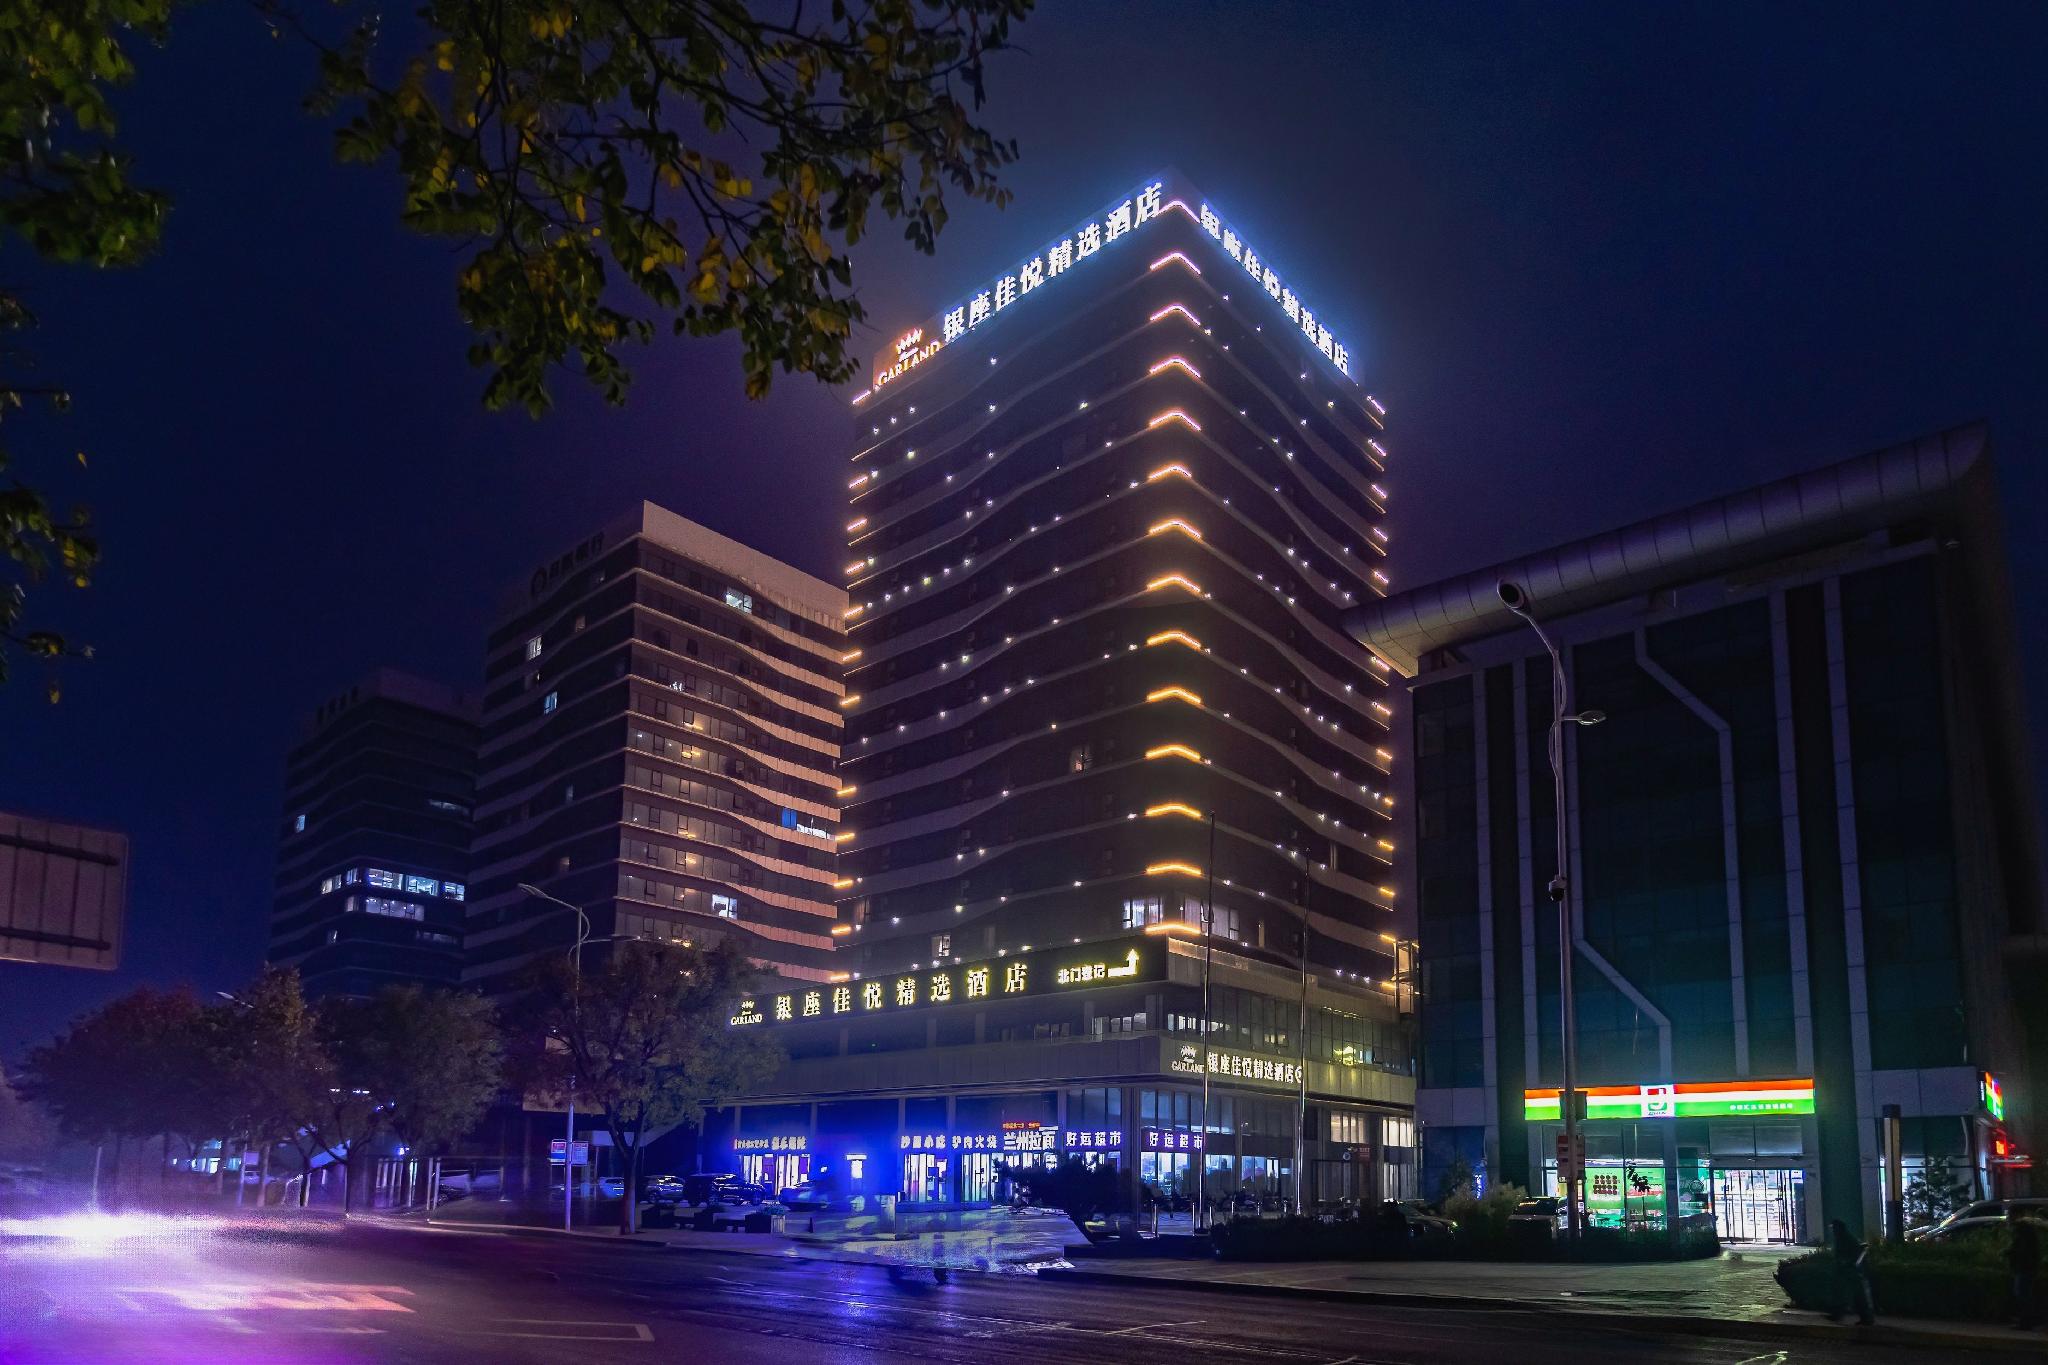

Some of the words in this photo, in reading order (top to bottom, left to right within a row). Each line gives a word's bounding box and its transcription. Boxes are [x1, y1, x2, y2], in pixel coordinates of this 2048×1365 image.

[943, 183, 1163, 343] 银座佳悦精选酒店
[878, 340, 941, 386] GARLAND
[776, 963, 1027, 1020] 银座佳悦精选酒店
[731, 1013, 763, 1025] GARLAND
[1207, 1051, 1294, 1083] 银座佳悦精选酒店
[1003, 1131, 1056, 1151] 兰州拉面
[1066, 1131, 1121, 1147] 好运超市
[1149, 1132, 1203, 1149] 好运超市
